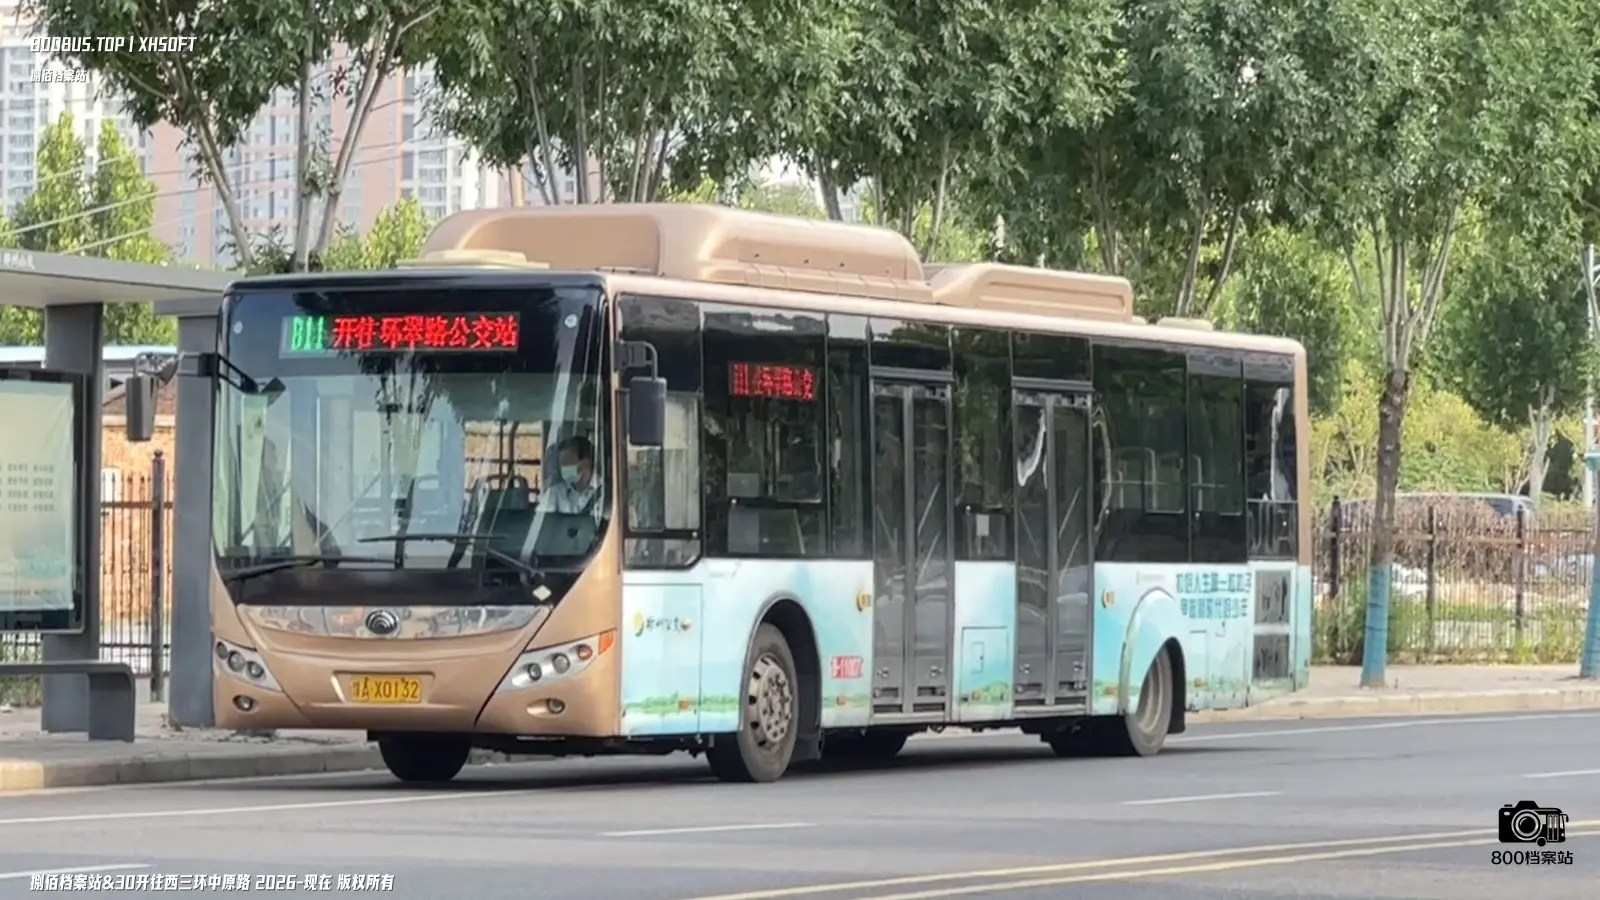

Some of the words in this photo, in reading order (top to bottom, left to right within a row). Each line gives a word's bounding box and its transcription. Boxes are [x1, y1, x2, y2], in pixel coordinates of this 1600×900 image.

[291, 316, 325, 350] B11
[333, 315, 517, 349] 开往环翠路公交站
